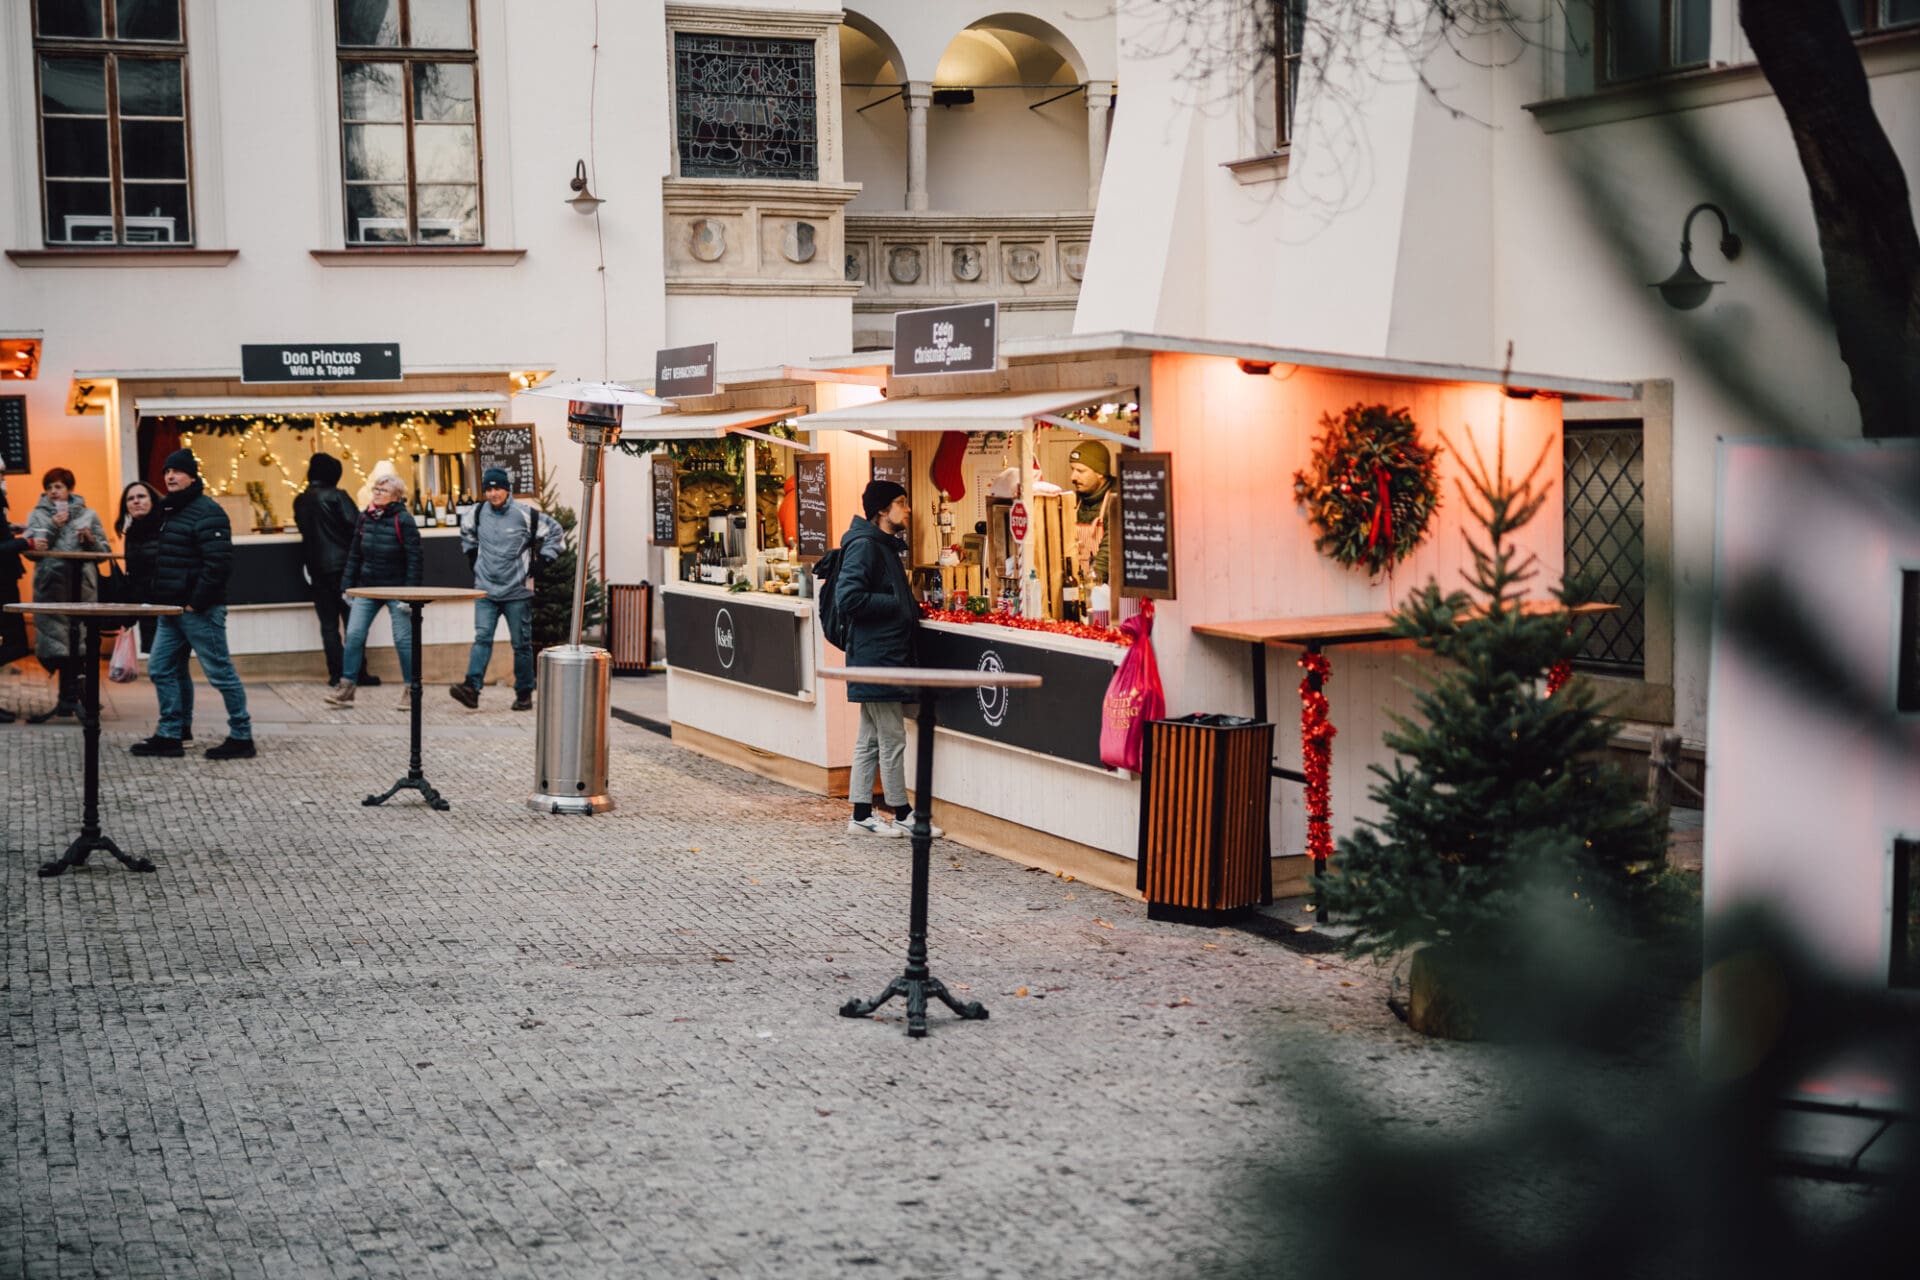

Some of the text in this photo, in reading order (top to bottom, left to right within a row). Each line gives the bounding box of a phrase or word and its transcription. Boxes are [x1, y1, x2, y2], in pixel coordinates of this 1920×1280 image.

[282, 349, 361, 365] Don Pintxos
[914, 343, 973, 366] Christmas goodies
[290, 365, 355, 377] Wine & Tapas
[1012, 516, 1027, 527] STOP
